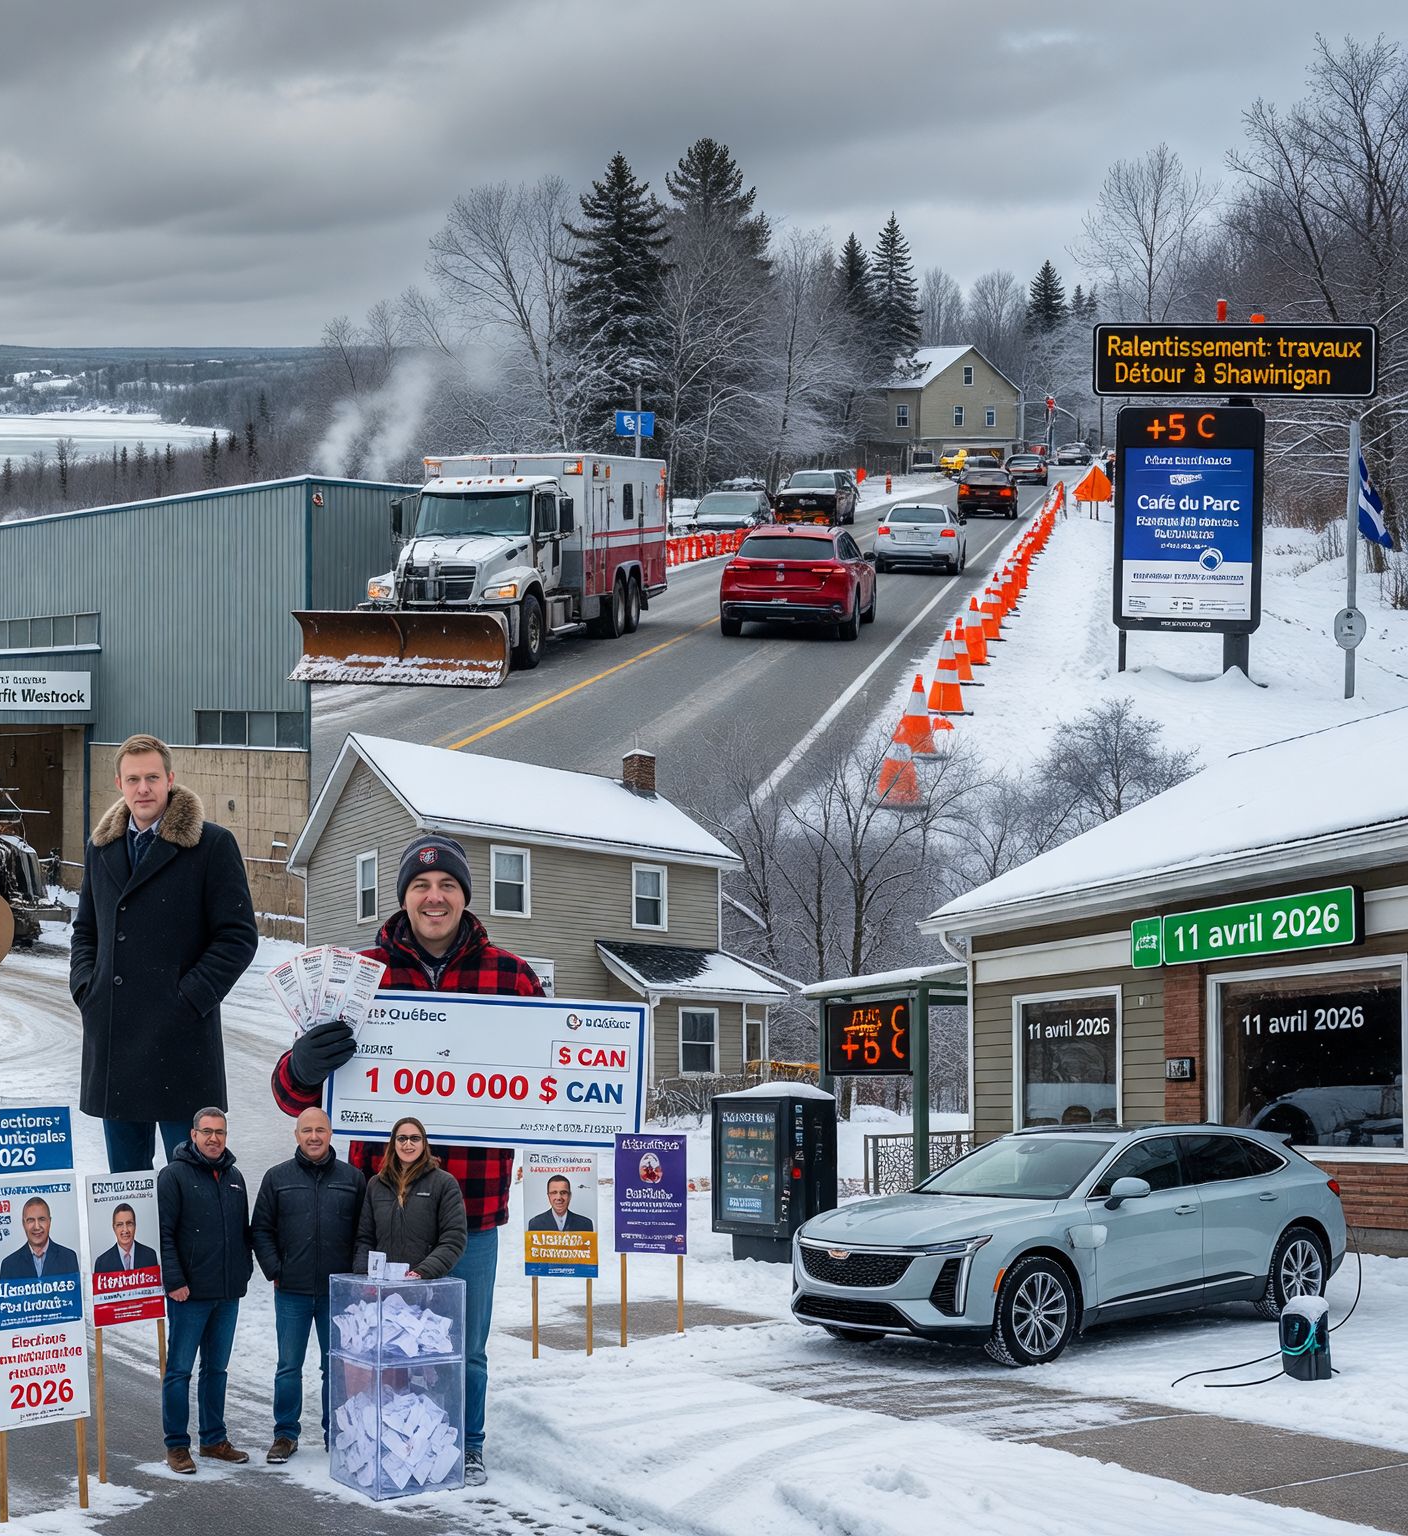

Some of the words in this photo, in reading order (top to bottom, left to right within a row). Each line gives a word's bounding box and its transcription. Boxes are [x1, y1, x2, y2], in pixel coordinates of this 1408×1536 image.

[1277, 337, 1362, 358] travaux
[1115, 362, 1185, 384] Détour
[1194, 362, 1206, 384] à
[1146, 413, 1186, 441] +5
[1197, 413, 1215, 438] C
[1137, 494, 1175, 510] Café
[1179, 495, 1199, 510] du
[1203, 496, 1240, 511] Parc
[22, 688, 85, 703] Westrock
[1174, 924, 1198, 952] 11
[1209, 913, 1263, 948] avril
[1272, 903, 1340, 940] 2026
[1028, 1023, 1041, 1040] 11
[1045, 1019, 1072, 1039] avril
[1076, 1017, 1110, 1036] 2026
[1242, 1014, 1261, 1035] 11
[1269, 1010, 1307, 1034] avril
[1314, 1006, 1364, 1030] 2026
[558, 1046, 571, 1065] $
[577, 1048, 626, 1068] CAN
[365, 1067, 380, 1093] 1
[393, 1069, 456, 1097] 000
[466, 1073, 529, 1100] 000
[538, 1075, 558, 1105] $
[566, 1081, 624, 1105] CAN
[10, 1378, 74, 1410] 2026
